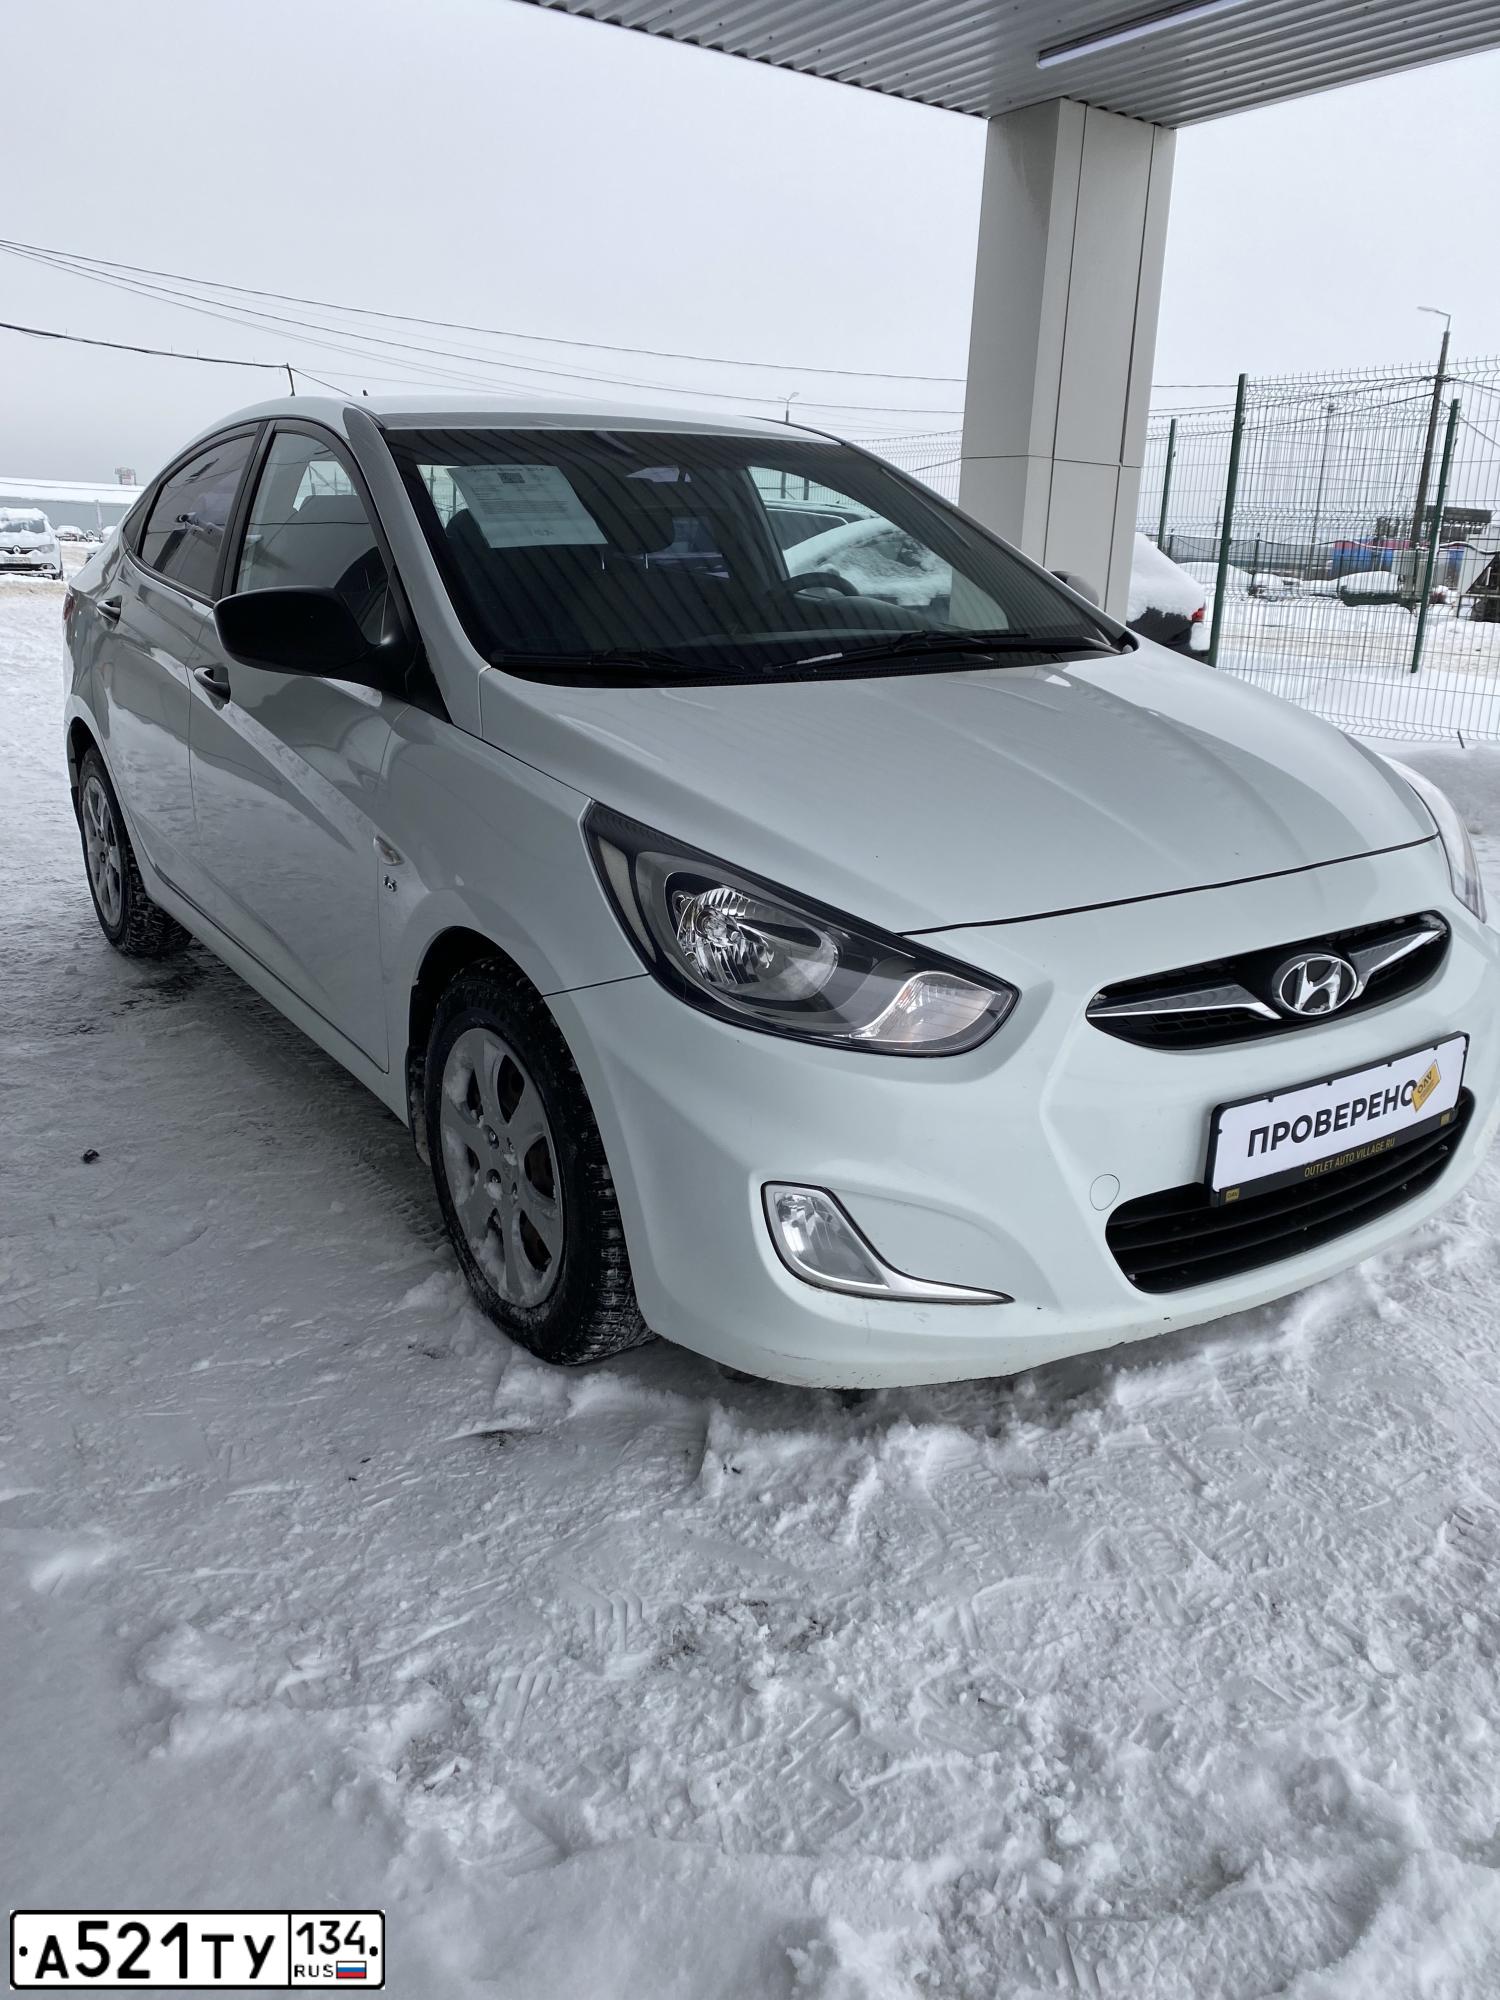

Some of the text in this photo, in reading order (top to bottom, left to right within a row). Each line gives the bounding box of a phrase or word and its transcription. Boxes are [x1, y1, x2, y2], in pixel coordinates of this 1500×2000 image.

[1248, 1079, 1417, 1157] ПРОВЕРЕНО
[1304, 1160, 1333, 1177] OUTLET
[1335, 1152, 1354, 1167] AUTO
